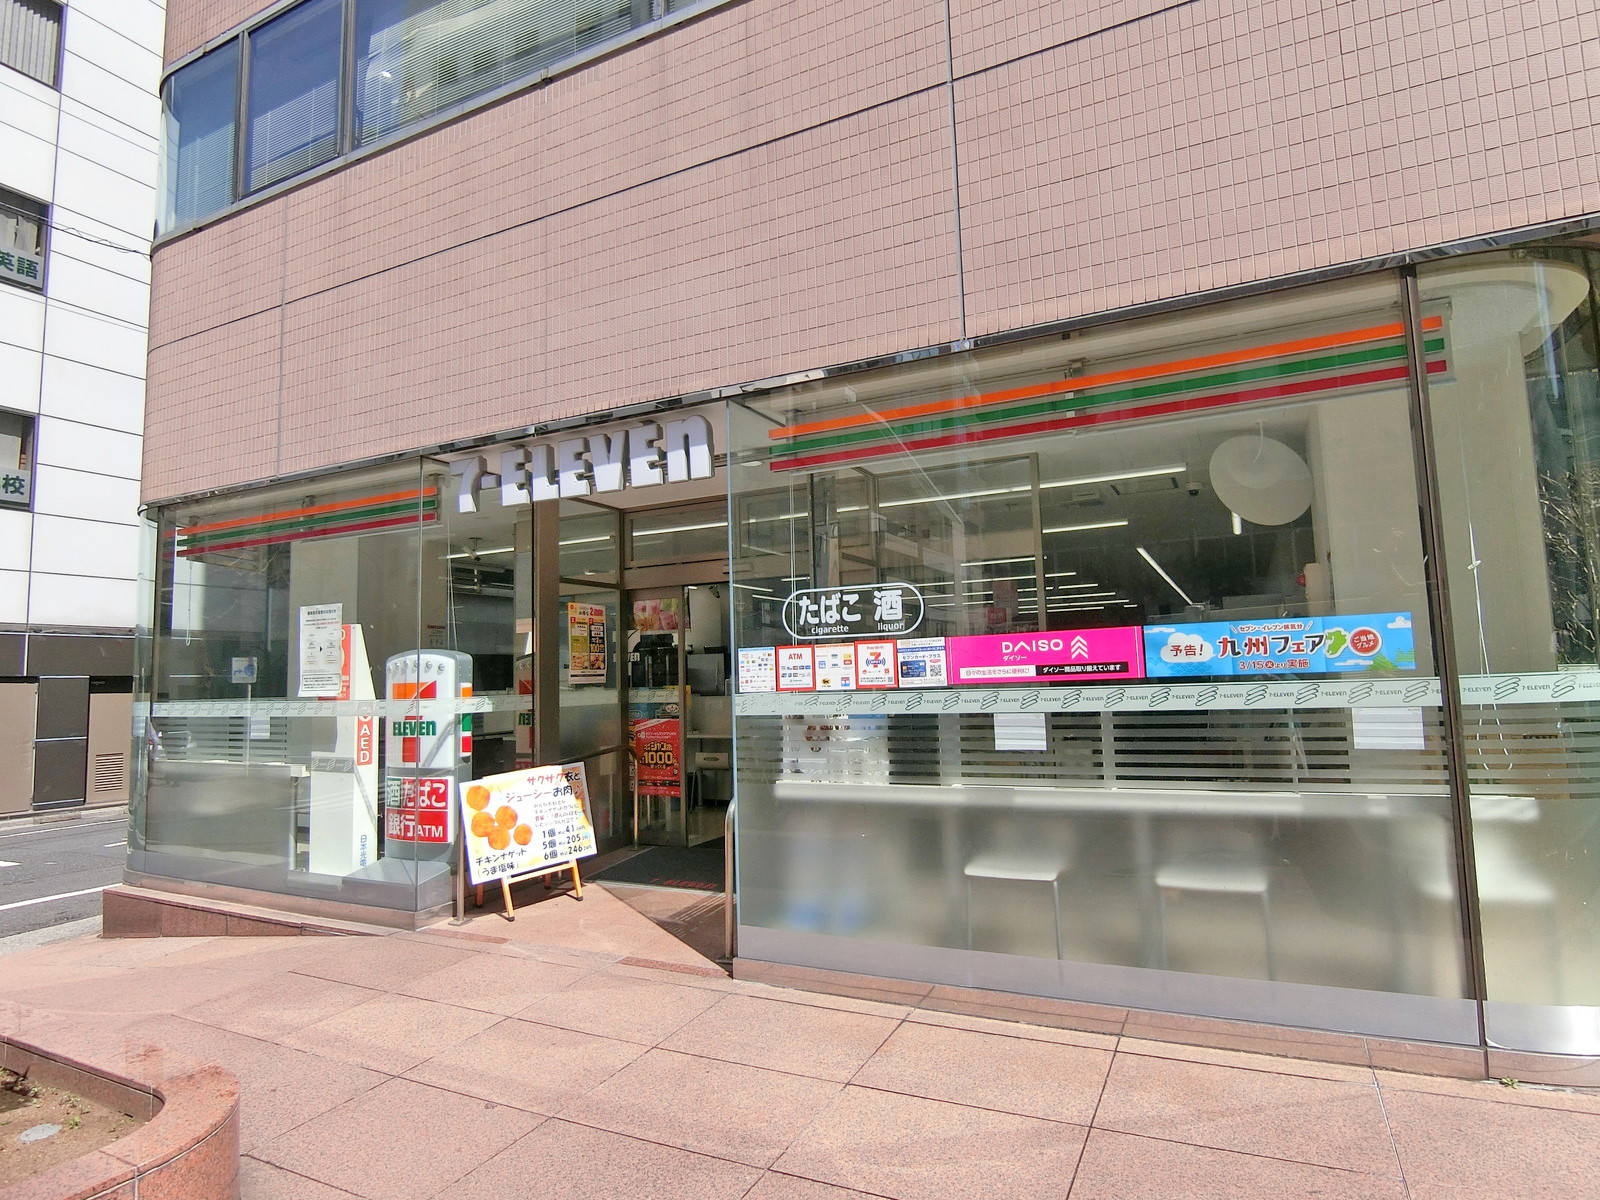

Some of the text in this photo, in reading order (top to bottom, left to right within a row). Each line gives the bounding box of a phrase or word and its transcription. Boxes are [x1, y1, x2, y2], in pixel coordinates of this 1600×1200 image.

[449, 415, 714, 513] 7-ELEVEN
[799, 589, 902, 625] たばこ 酒
[811, 621, 904, 634] cigarette liquor
[1001, 638, 1063, 653] DAISO
[1170, 643, 1204, 657] 予告!
[1218, 634, 1324, 658] 九州フェア
[1356, 641, 1375, 650] グルメ
[1003, 654, 1027, 662] ダイソー
[392, 720, 437, 737] ELEVEN
[360, 723, 371, 763] AED
[644, 752, 673, 764] 1000
[527, 771, 581, 786] サクサク衣と
[403, 780, 447, 808] たばこ
[476, 848, 527, 866] チキンナゲット
